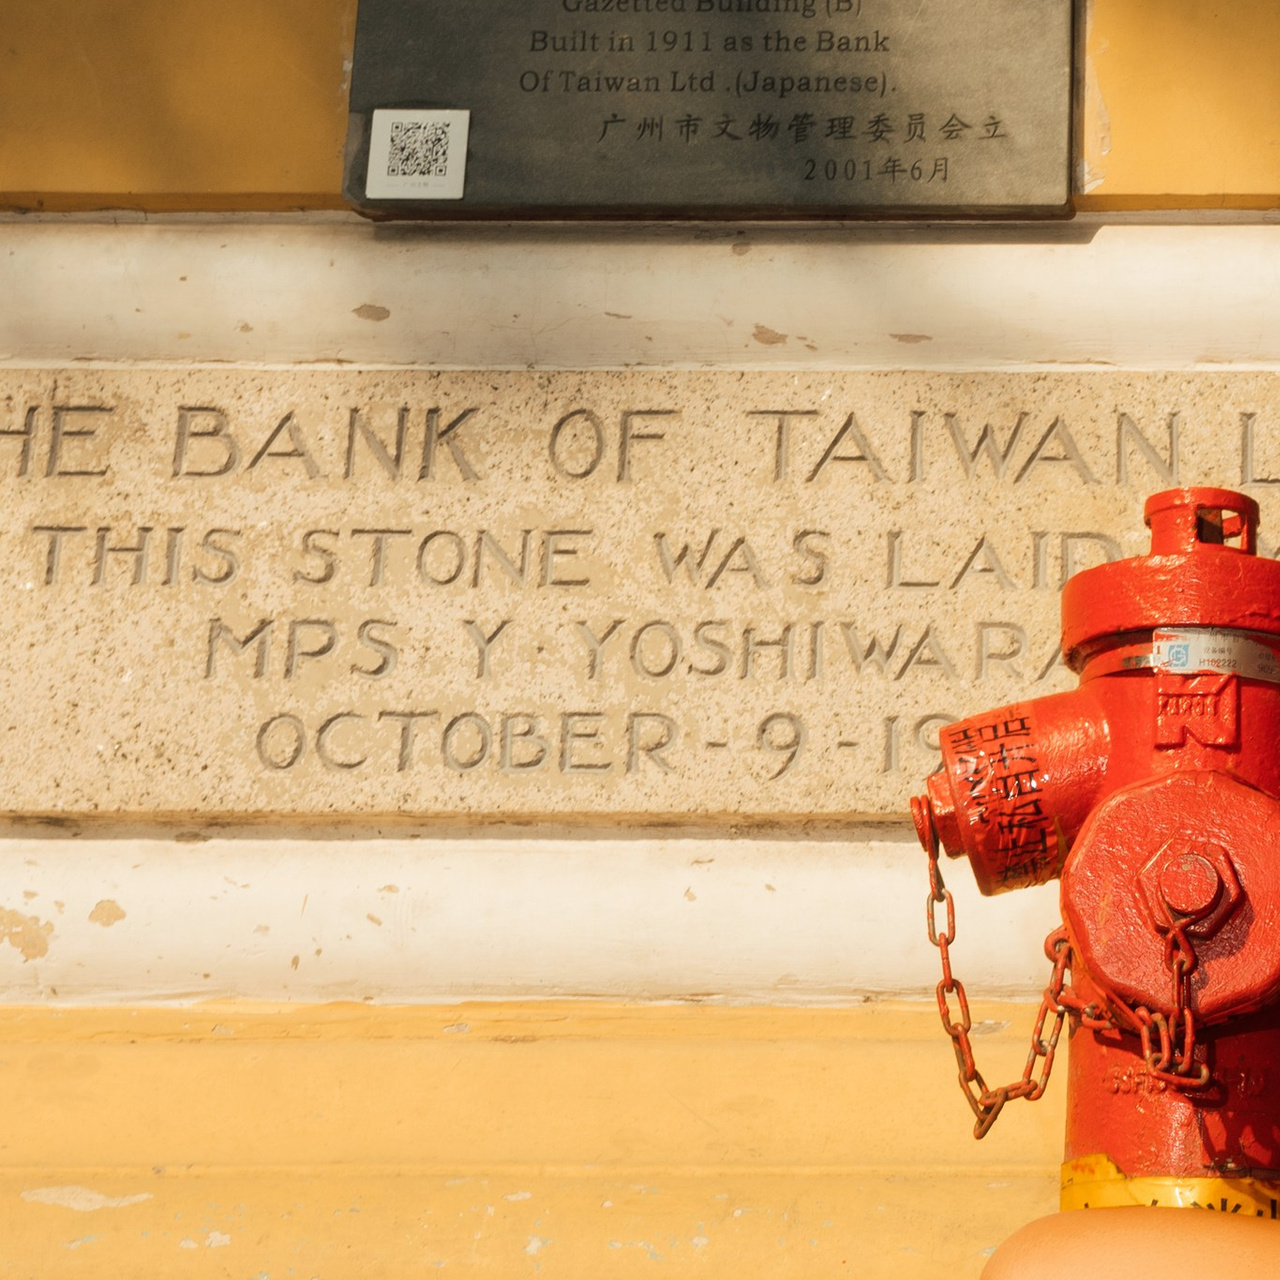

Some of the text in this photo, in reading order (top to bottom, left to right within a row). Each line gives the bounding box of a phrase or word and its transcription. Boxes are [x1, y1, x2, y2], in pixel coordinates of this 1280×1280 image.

[529, 30, 891, 53] Built in 1911 as the Bank
[518, 70, 553, 93] Of
[559, 70, 661, 93] Taiwan
[669, 70, 716, 93] Ltd
[597, 112, 1008, 145] 广州市文物管理委员会立
[803, 156, 950, 185] 2001年6月
[172, 405, 481, 482] BANK
[548, 407, 682, 483] OF
[747, 409, 1182, 486] TAIWAN
[33, 525, 242, 588] THIS
[294, 528, 593, 590] STONE
[652, 528, 831, 591] WAS
